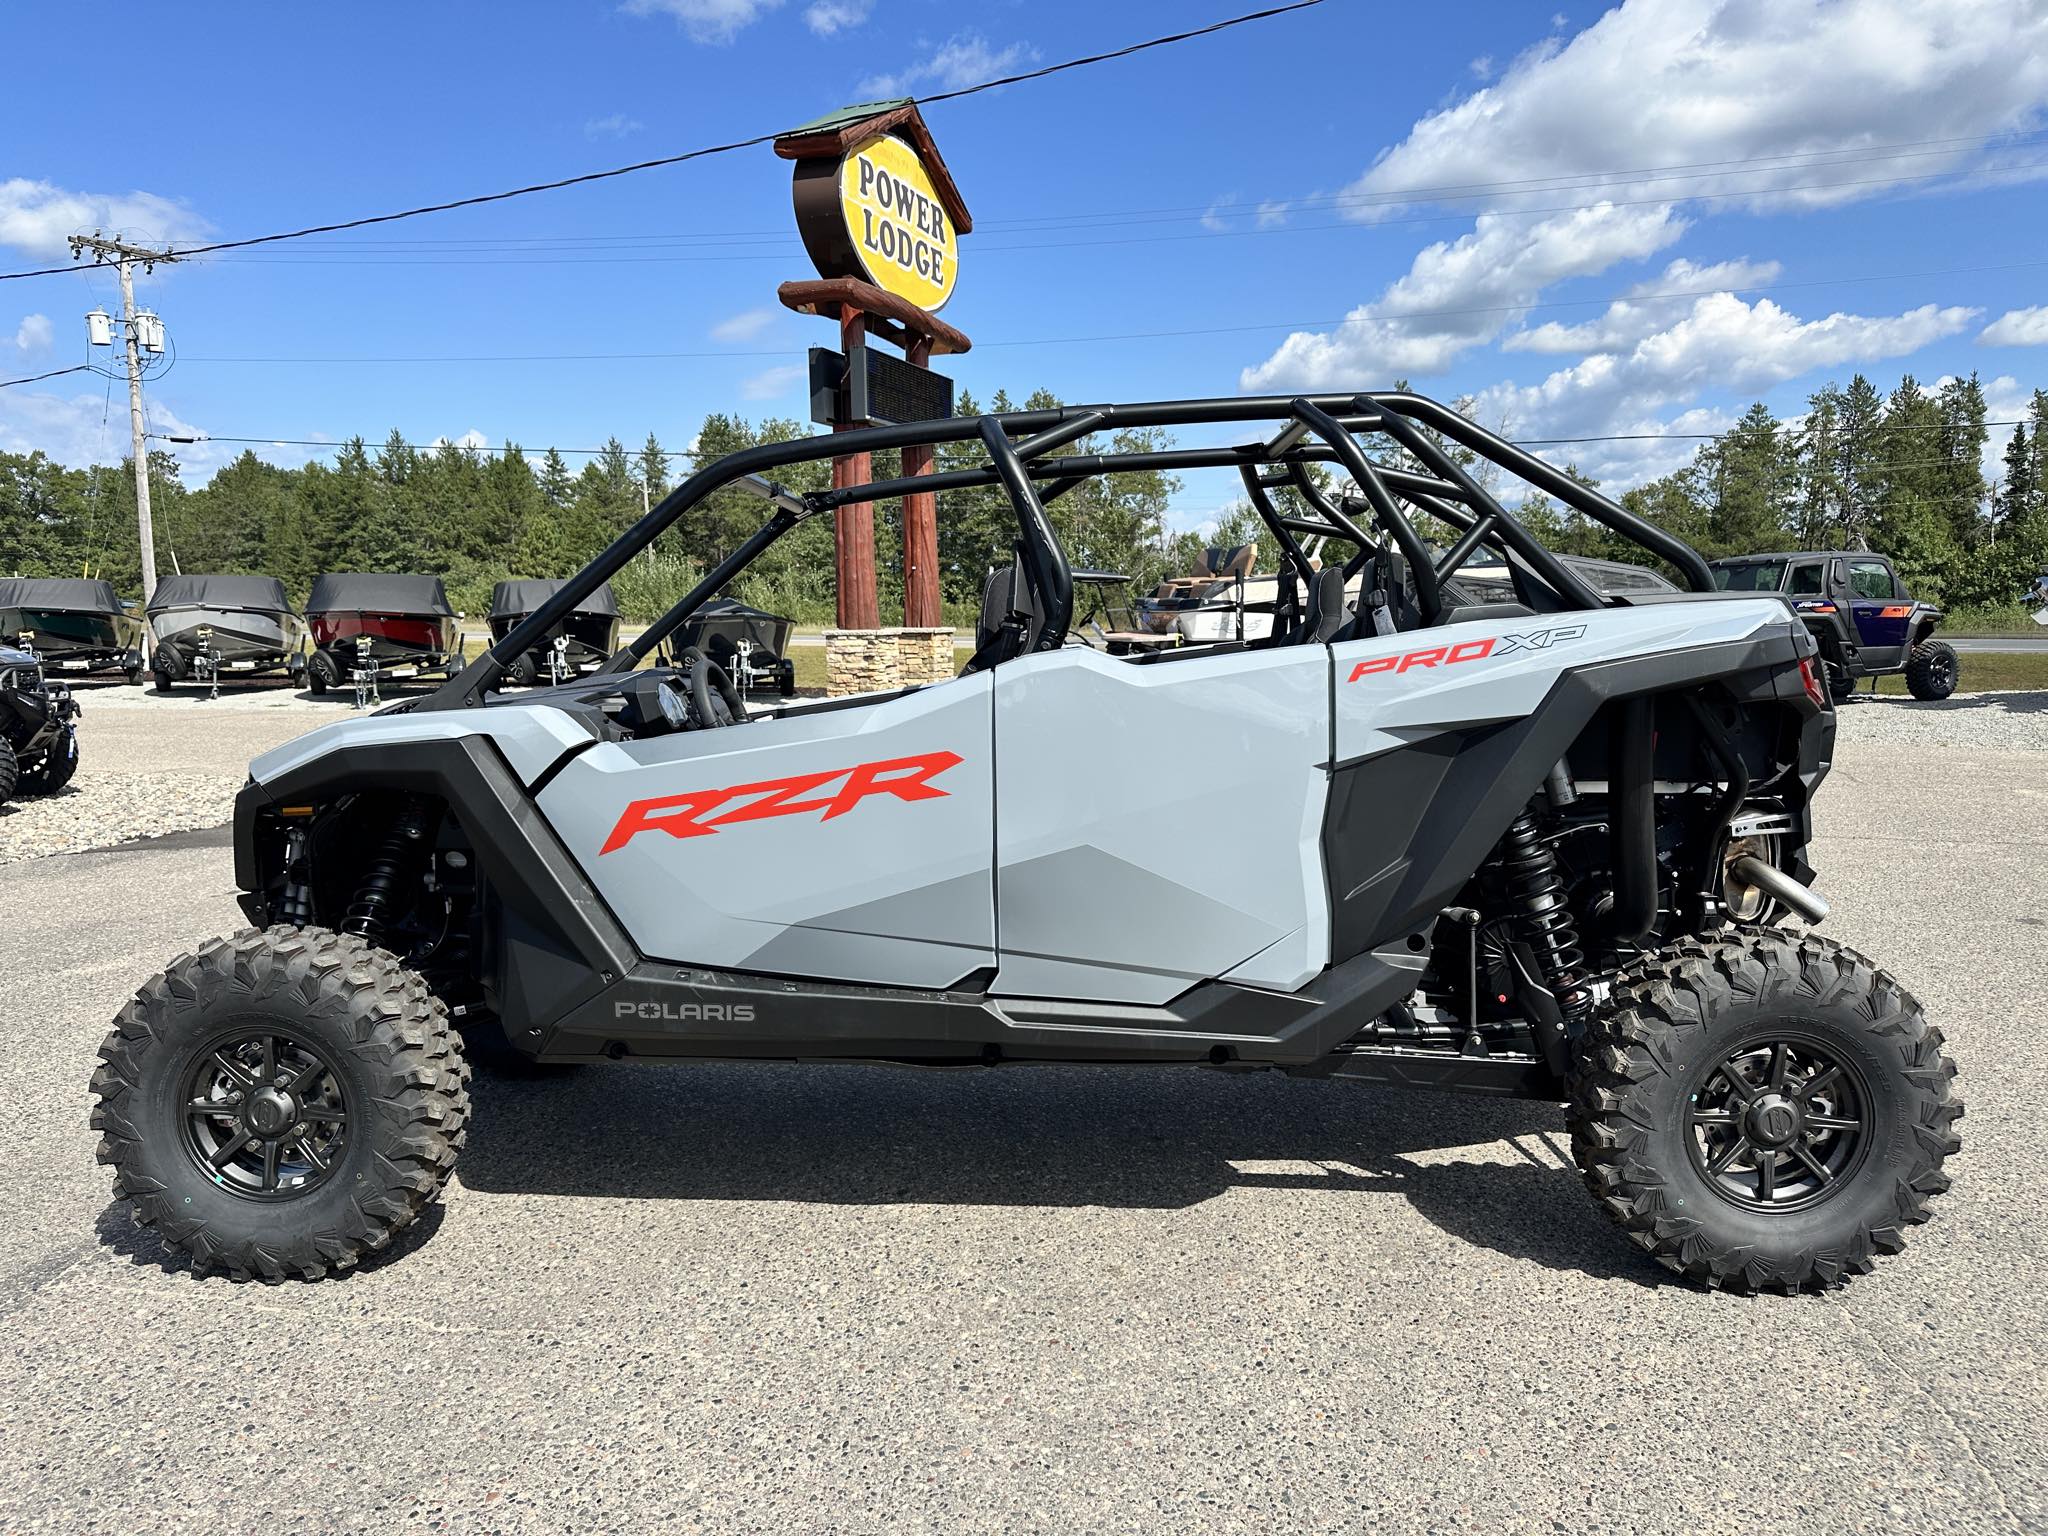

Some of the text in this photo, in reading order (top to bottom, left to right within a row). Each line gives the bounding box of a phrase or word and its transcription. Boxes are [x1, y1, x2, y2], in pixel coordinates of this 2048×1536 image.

[859, 156, 945, 244] POWER
[864, 208, 943, 286] LODGE
[1347, 624, 1588, 682] PRO XP
[599, 751, 965, 856] RZR
[615, 1002, 755, 1021] POLARIS
